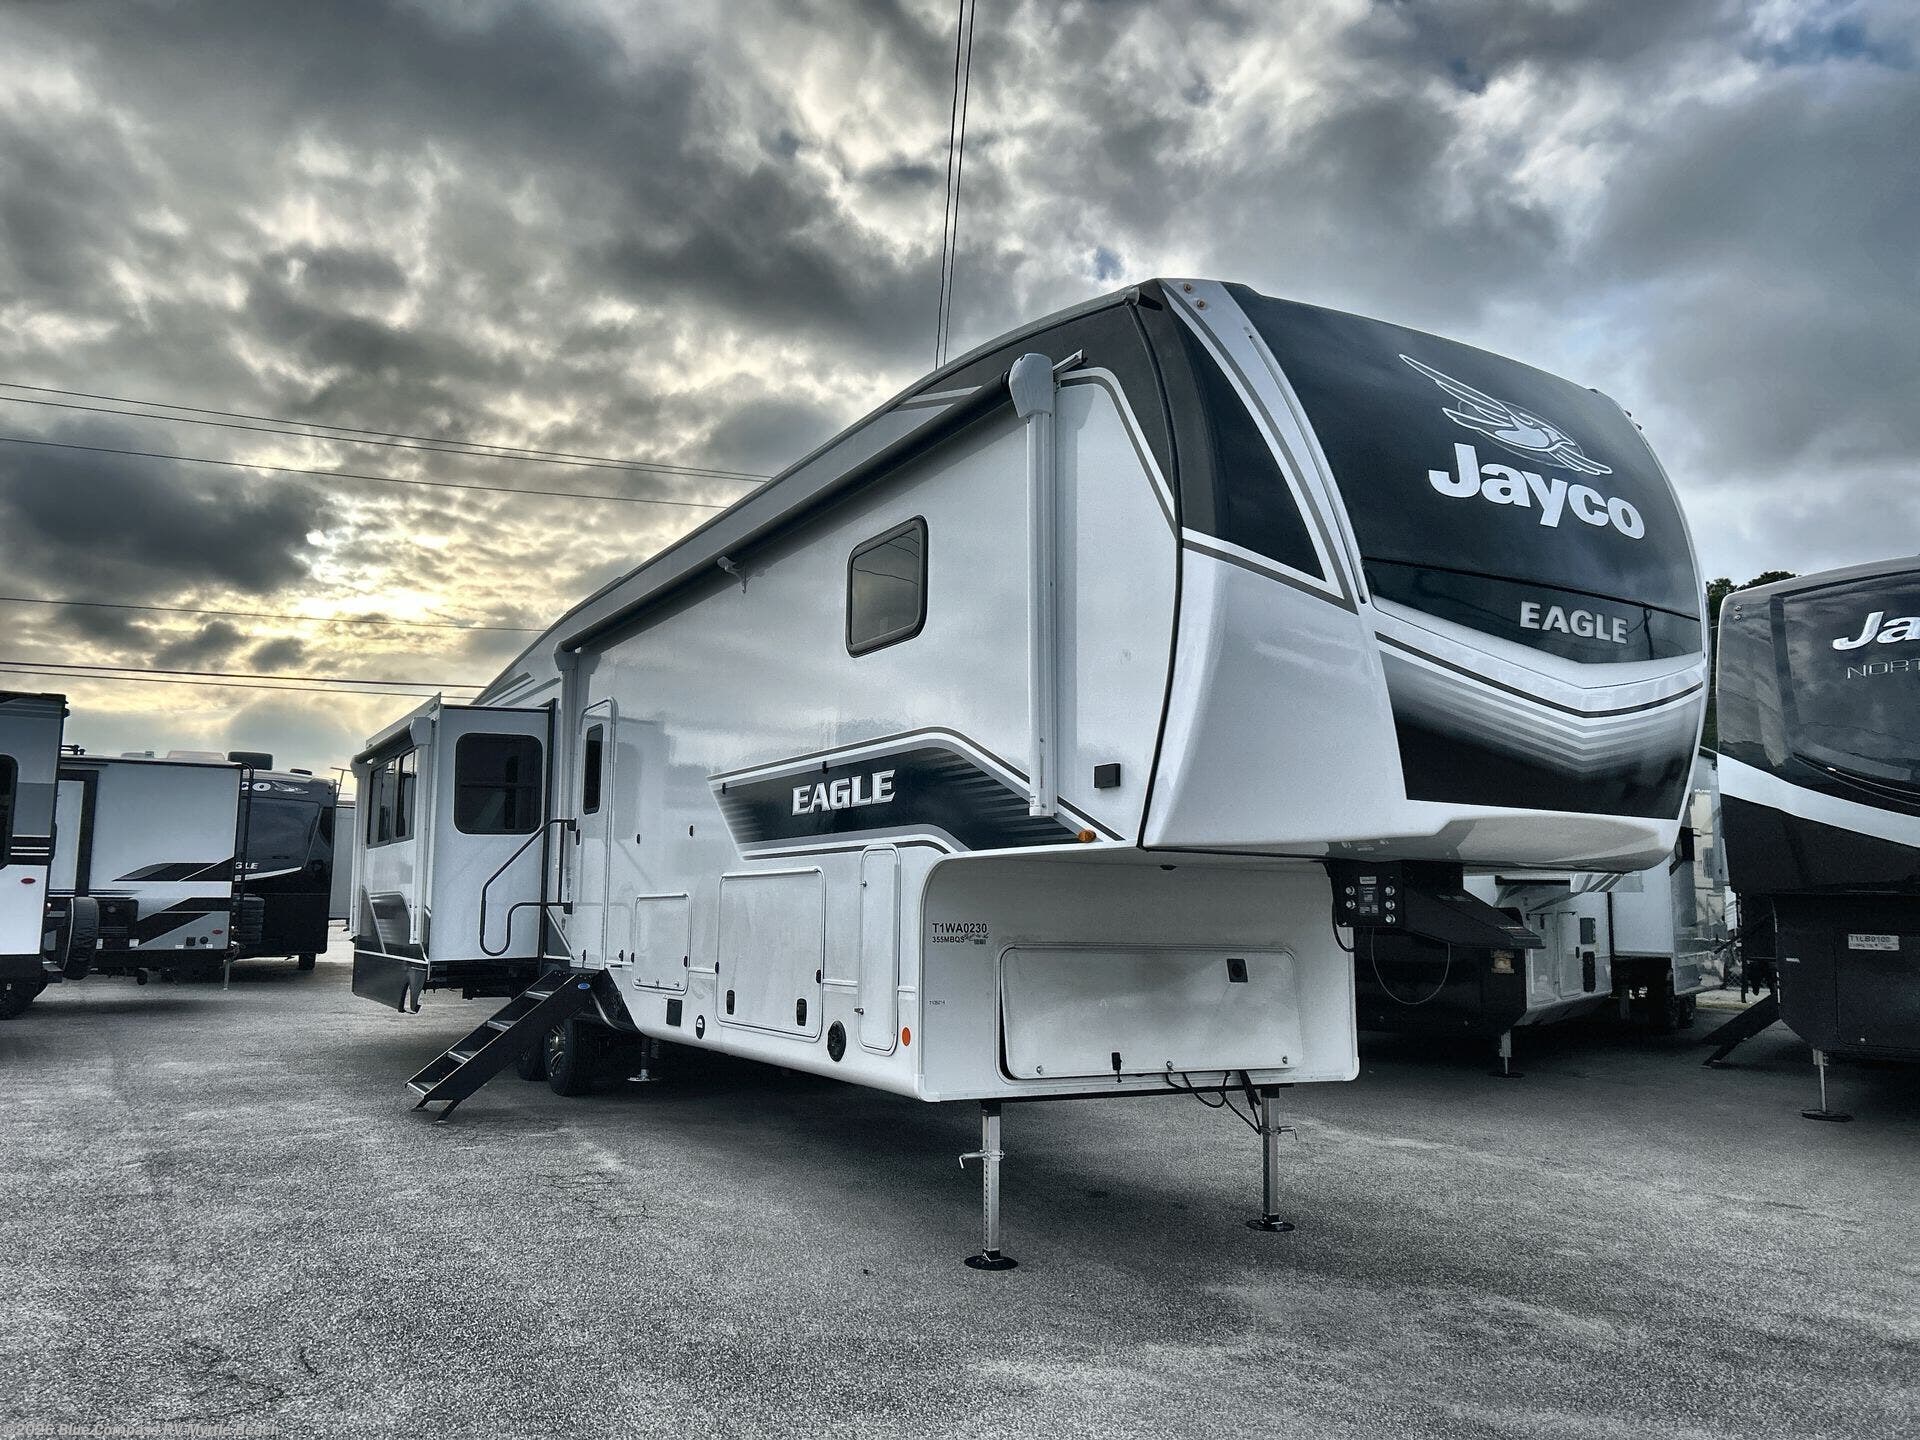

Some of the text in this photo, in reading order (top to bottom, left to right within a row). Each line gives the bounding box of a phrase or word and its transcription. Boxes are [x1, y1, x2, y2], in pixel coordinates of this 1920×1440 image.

[1428, 442, 1645, 540] Jayco
[1519, 600, 1629, 645] EAGLE
[791, 769, 896, 816] EAGLE
[932, 922, 988, 934] T1WA0230
